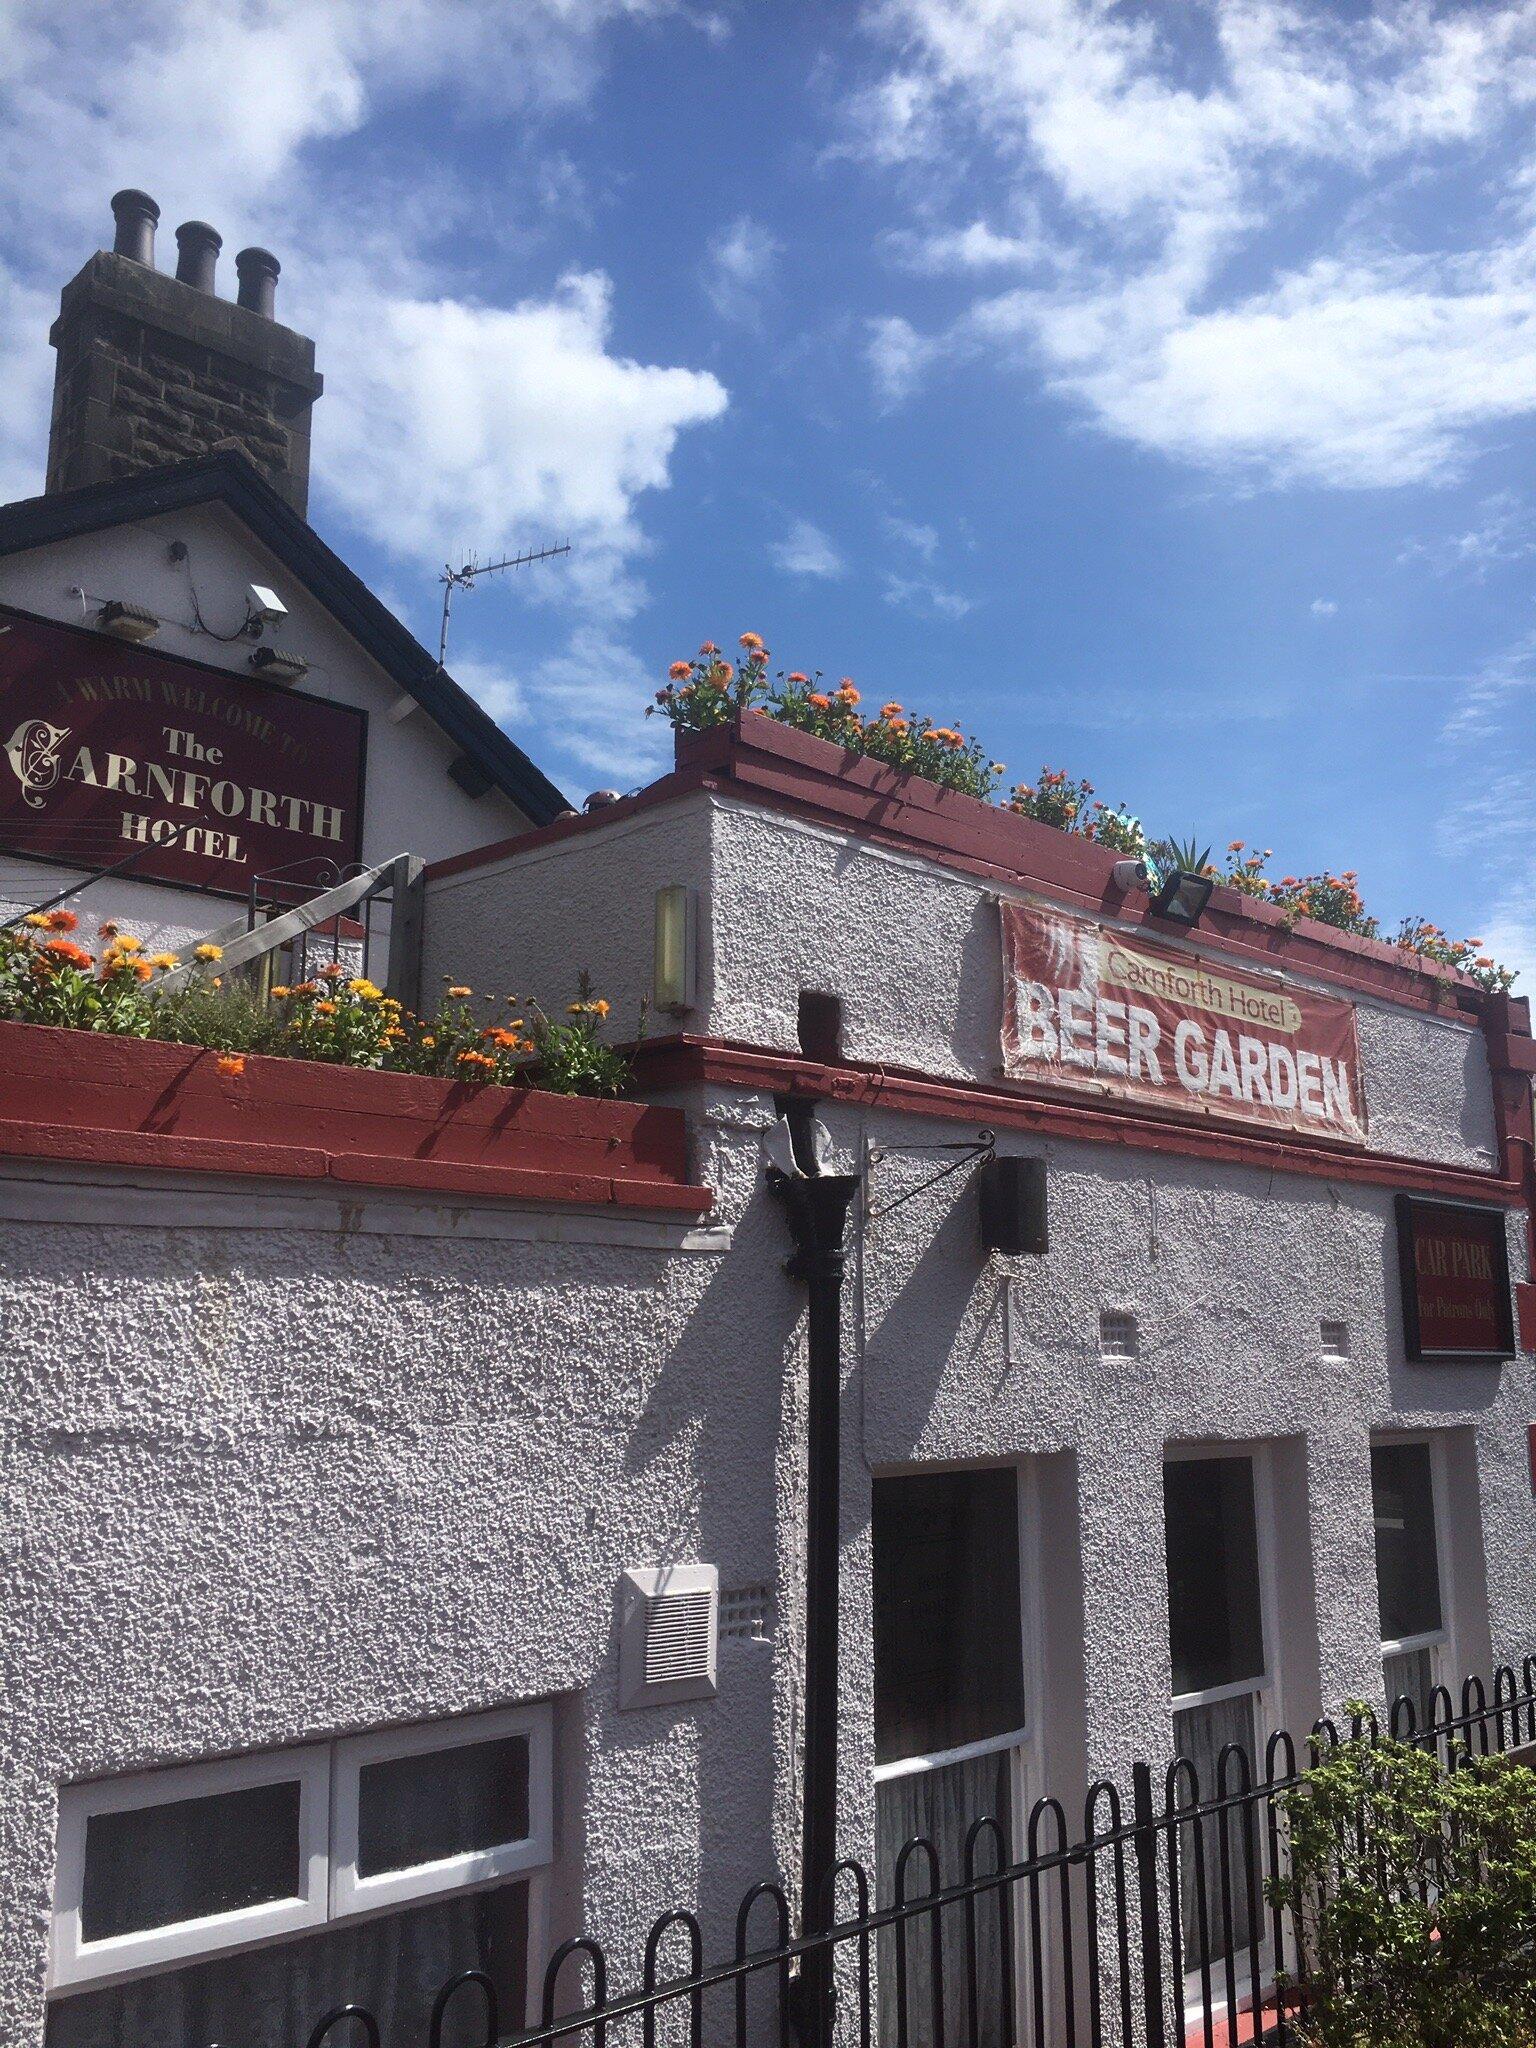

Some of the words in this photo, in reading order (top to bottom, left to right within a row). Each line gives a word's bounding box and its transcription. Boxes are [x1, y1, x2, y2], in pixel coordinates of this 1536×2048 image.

[75, 676, 152, 702] WARM
[160, 680, 276, 745] WELCOME
[162, 726, 224, 765] The
[2, 718, 346, 843] CARNFORTH
[120, 811, 248, 864] HOTEL
[1107, 950, 1223, 1010] Carnforth
[1229, 986, 1286, 1027] Hotel
[1014, 977, 1167, 1085] BEER
[1174, 1019, 1357, 1126] GARDEN
[1414, 1236, 1448, 1276] CAR
[1452, 1242, 1492, 1279] PARK
